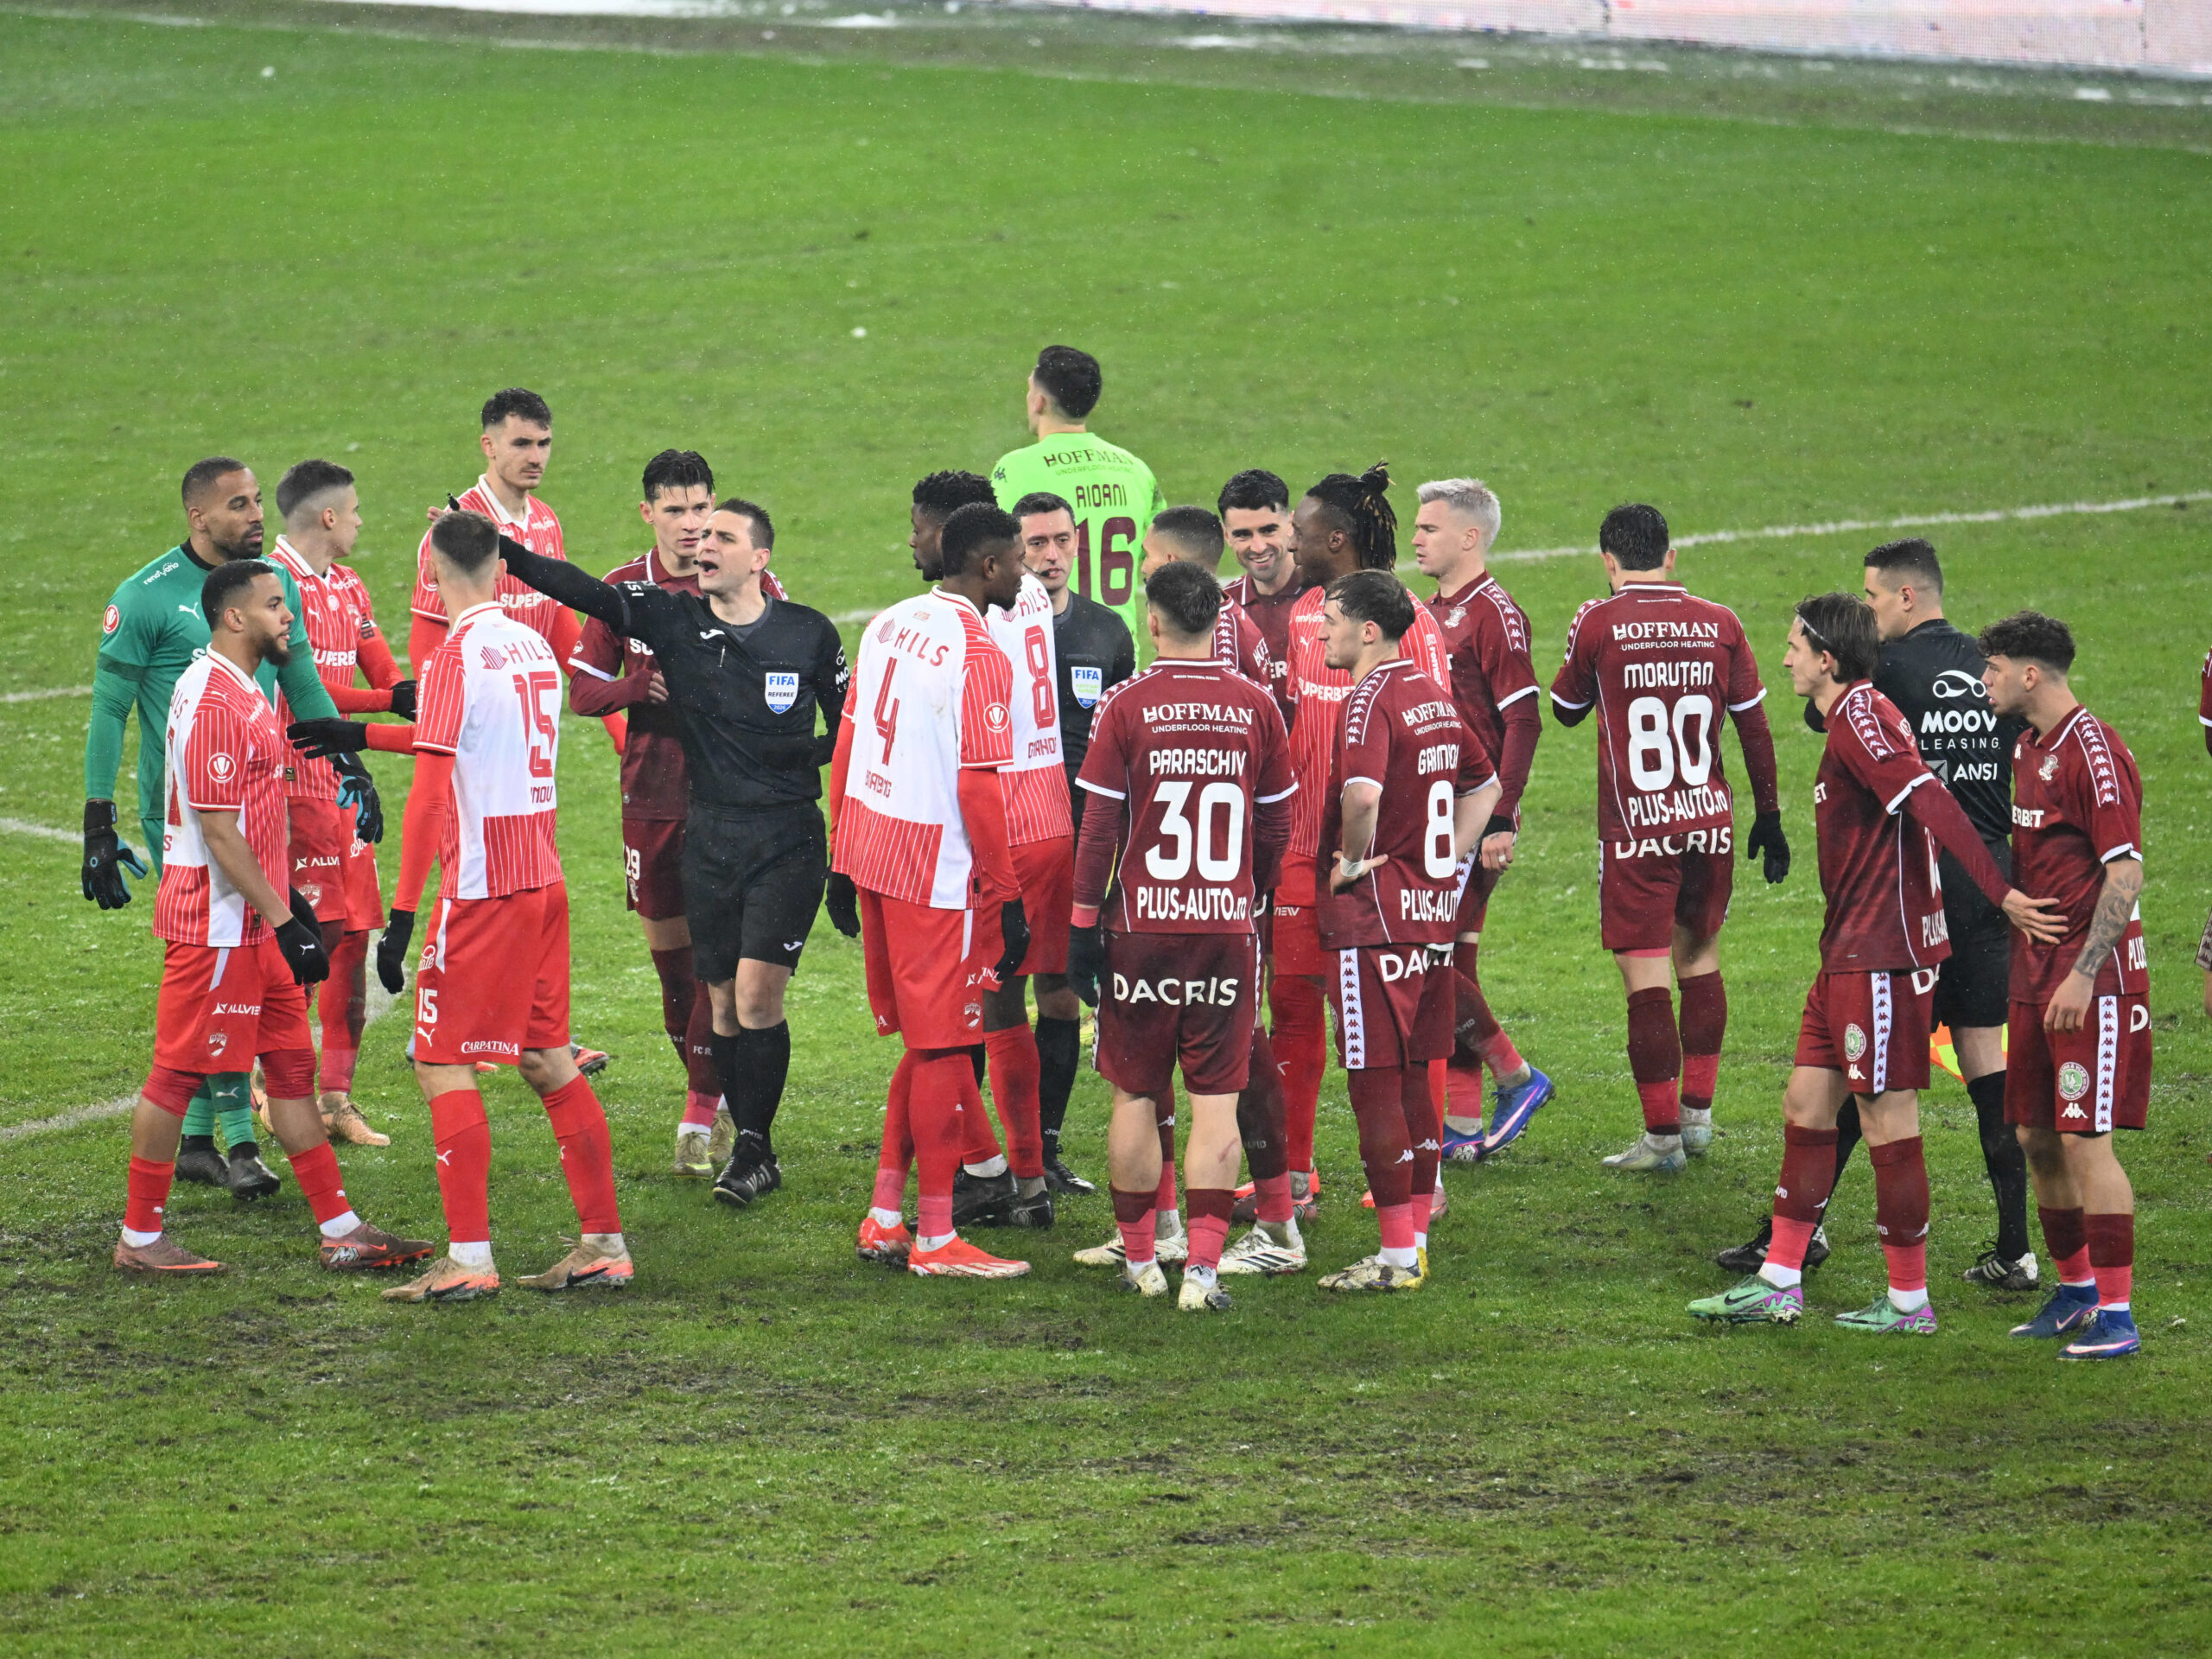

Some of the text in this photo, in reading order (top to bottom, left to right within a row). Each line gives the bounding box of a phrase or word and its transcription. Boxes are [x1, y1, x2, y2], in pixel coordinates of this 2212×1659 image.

[1043, 448, 1135, 467] HOFFMAN
[1075, 517, 1137, 607] 16
[1612, 622, 1719, 641] HOFFMAN
[1621, 640, 1679, 652] UNDERFLOOR
[504, 639, 553, 664] HILS
[894, 626, 950, 667] HILS
[769, 676, 795, 685] FIFA
[1025, 625, 1057, 730] 8
[1075, 670, 1099, 680] FIFA
[512, 671, 557, 779] 15
[874, 656, 899, 766] 4
[1142, 702, 1254, 725] HOFFMAN
[1402, 701, 1458, 728] HOFFMAN
[1921, 709, 1998, 734] MOOV
[1152, 723, 1249, 734] UNDERFLOOR HEATING
[1628, 694, 1713, 791] 80
[1921, 737, 1999, 751] LEASING
[1149, 748, 1247, 777] PARASCHIV
[1953, 762, 1998, 782] ANSI
[1628, 785, 1728, 827] PLUS-AUTO.ro
[1145, 781, 1245, 882] 30
[1424, 779, 1457, 879] 8
[1615, 827, 1732, 859] DACRIS
[1137, 886, 1247, 921] PLUS-AUTO.ro
[1113, 972, 1239, 1007] DACRIS
[418, 987, 438, 1024] 15
[461, 1039, 520, 1056] CARPATINA
